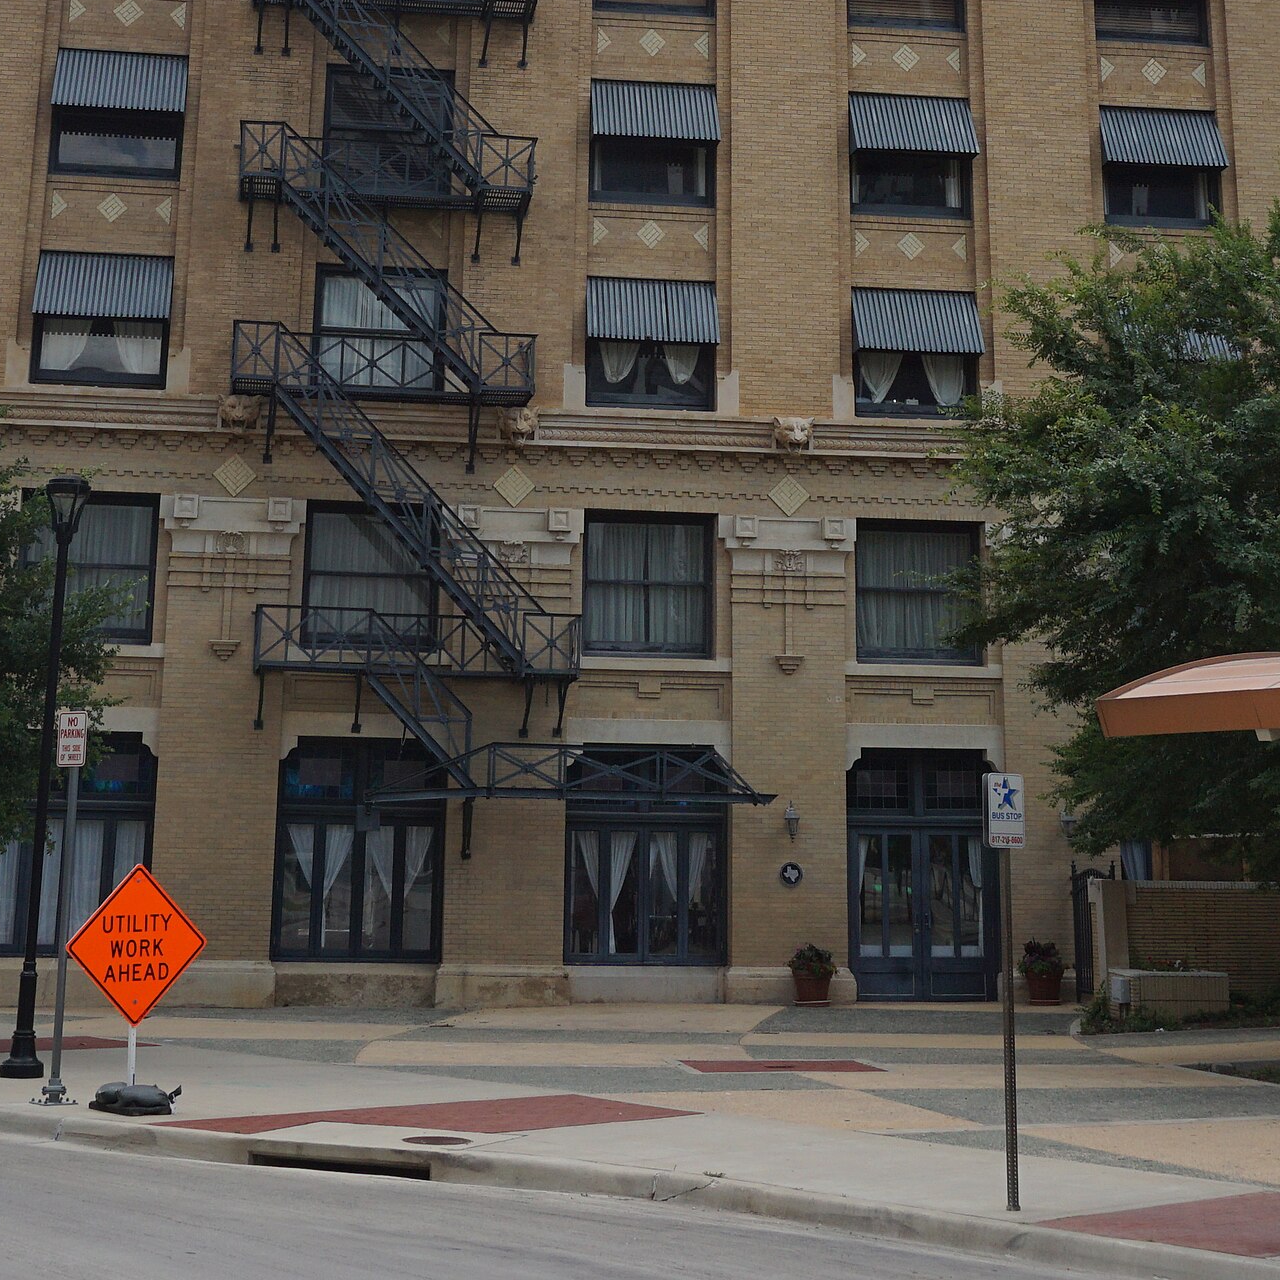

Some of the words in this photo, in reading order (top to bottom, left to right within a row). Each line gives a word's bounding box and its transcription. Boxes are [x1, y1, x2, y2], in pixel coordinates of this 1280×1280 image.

[67, 717, 78, 727] NO
[60, 729, 85, 738] PARKING
[102, 914, 172, 933] UTILITY
[110, 938, 163, 958] WORK
[103, 963, 169, 983] AHEAD
